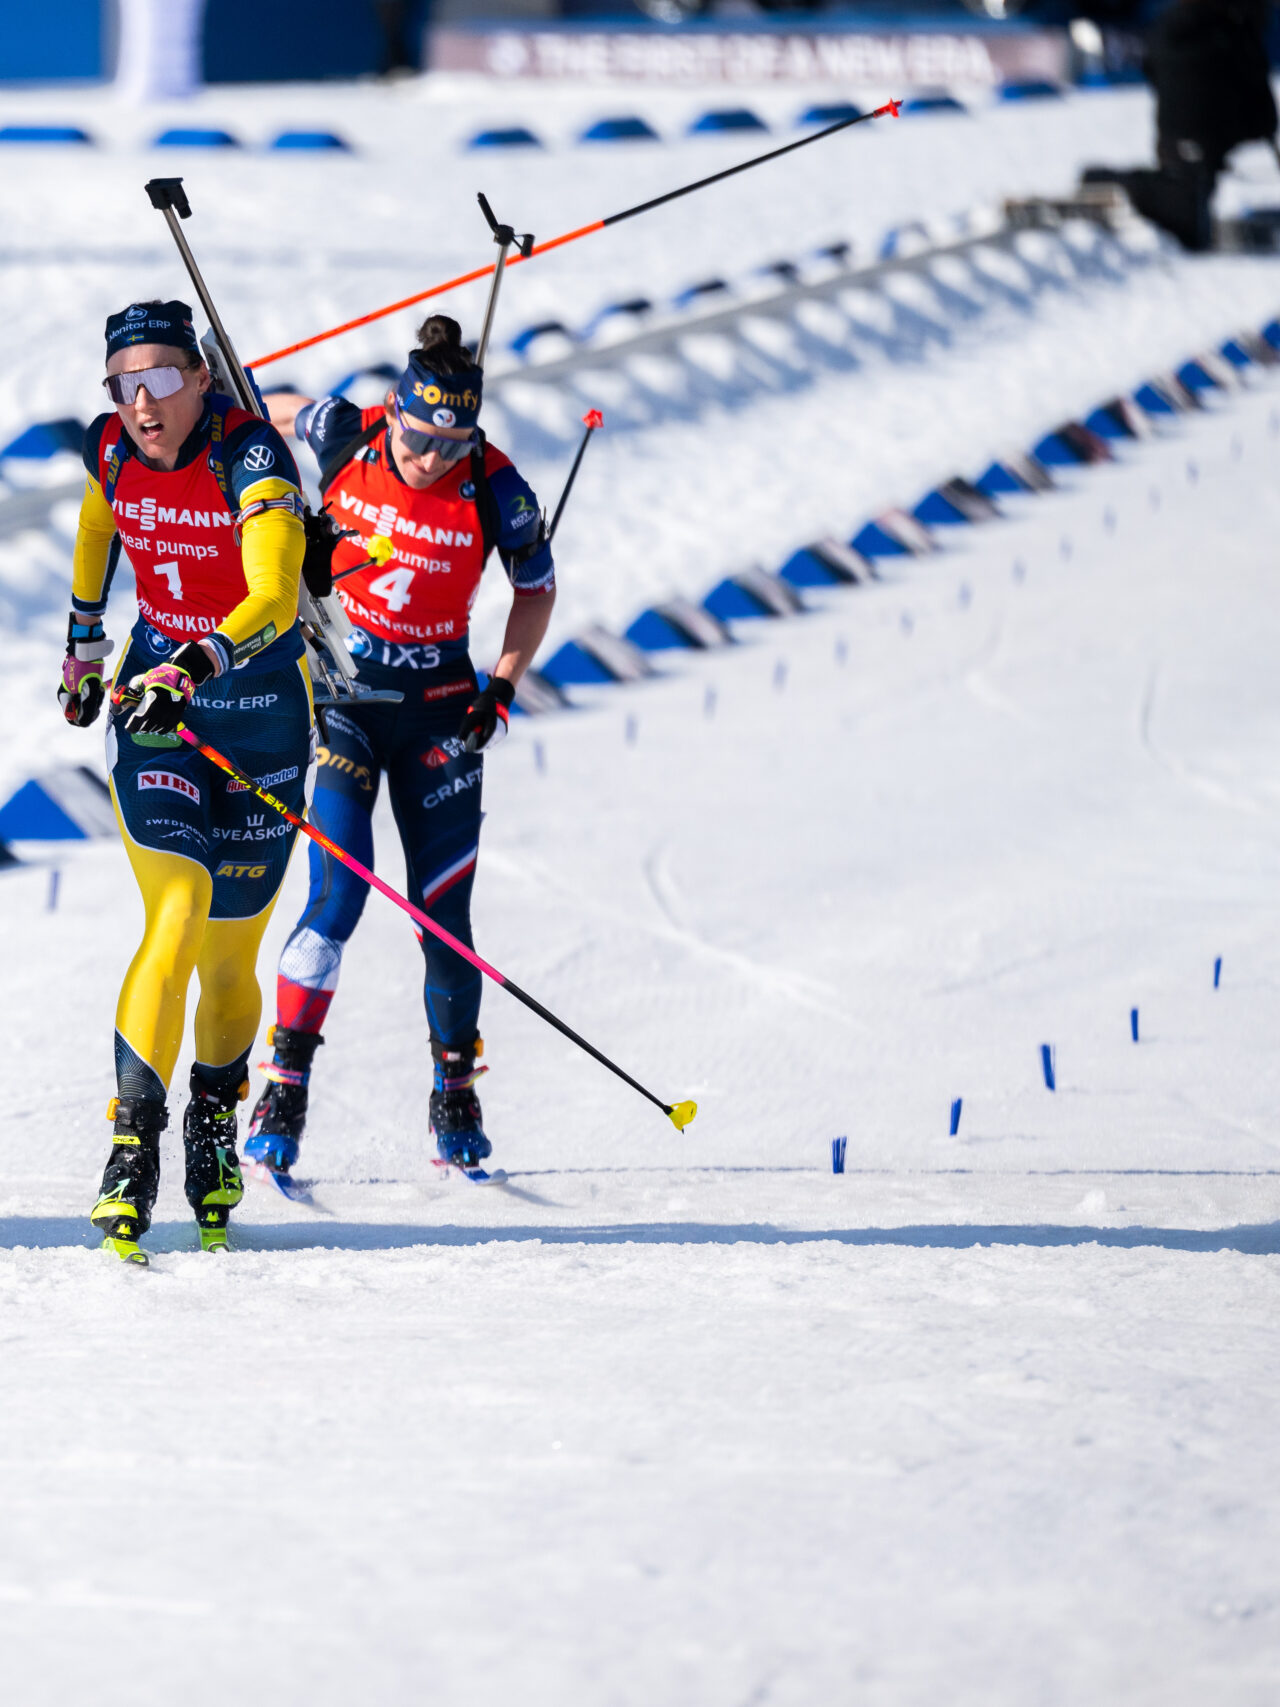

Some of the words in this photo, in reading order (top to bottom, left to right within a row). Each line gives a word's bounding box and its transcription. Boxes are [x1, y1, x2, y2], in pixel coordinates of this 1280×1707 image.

[149, 320, 171, 329] ERP
[413, 381, 478, 411] somfy
[340, 490, 473, 547] VIESSMANN
[119, 528, 151, 551] Heat
[156, 540, 219, 560] pumps
[153, 560, 183, 600] 1
[369, 567, 415, 612] 4
[239, 694, 277, 709] ERP
[316, 747, 373, 791] omfy
[141, 774, 199, 801] NIBE
[423, 768, 482, 808] CRAFT
[212, 822, 293, 841] SVEASKOG
[217, 864, 268, 878] ATG
